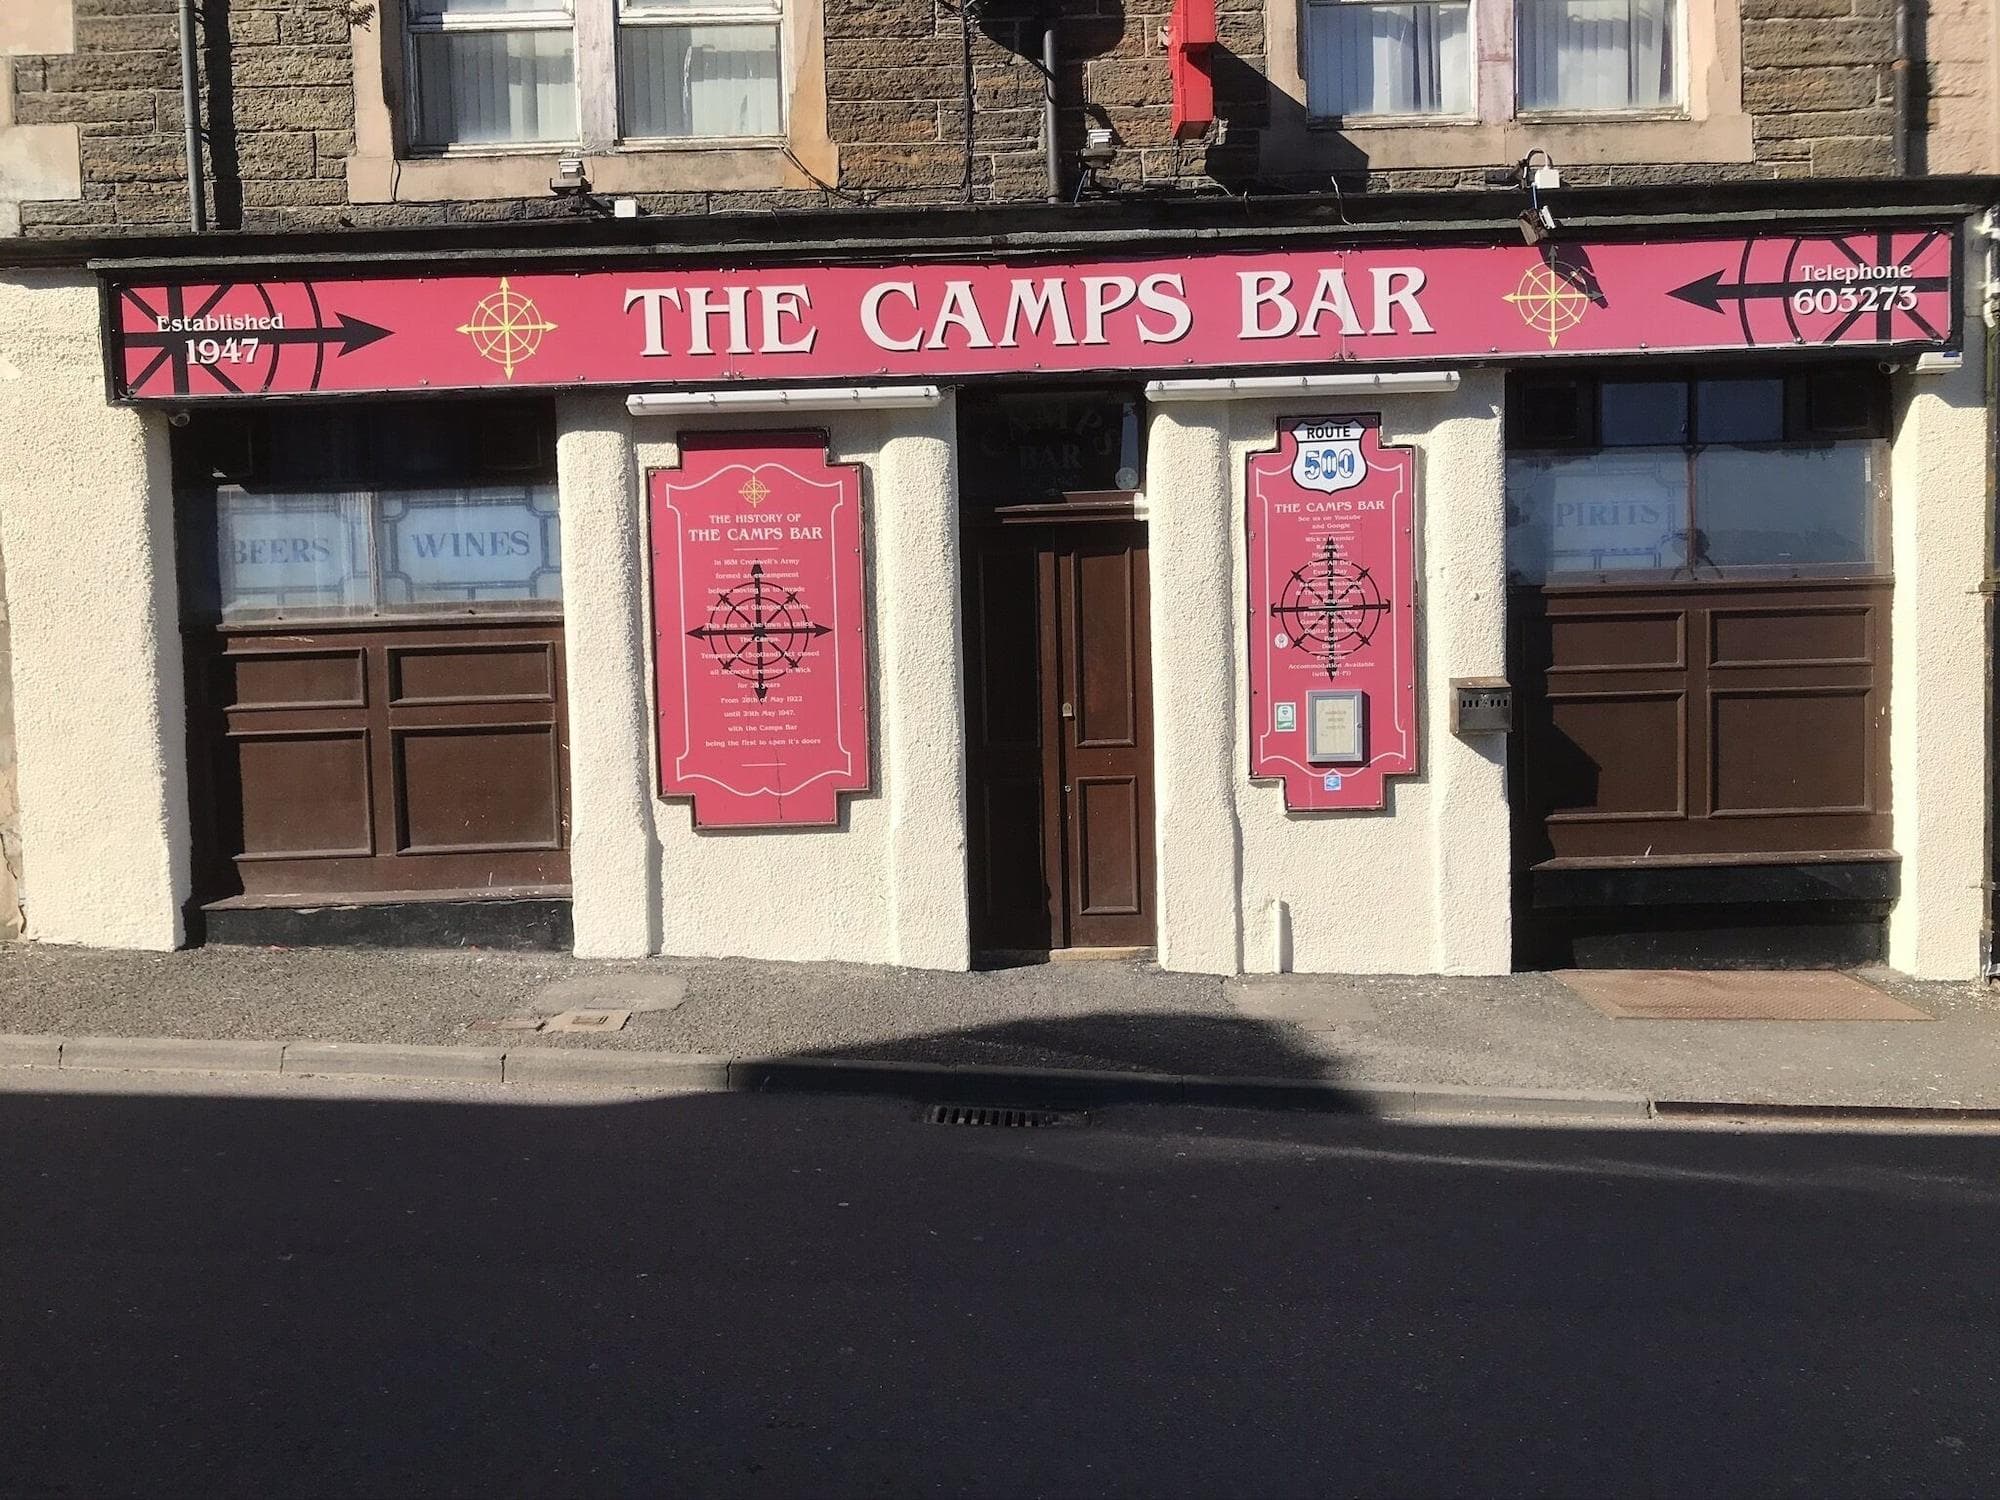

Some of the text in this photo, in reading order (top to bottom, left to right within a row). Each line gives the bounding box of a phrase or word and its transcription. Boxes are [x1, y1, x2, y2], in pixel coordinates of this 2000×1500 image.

[1801, 262, 1912, 285] Telephone
[623, 267, 1436, 357] THE CAMPS BAR
[1793, 286, 1918, 315] 603273
[156, 312, 284, 332] Established
[185, 337, 259, 365] 1947
[1307, 426, 1350, 439] ROUTE
[1305, 449, 1355, 480] 500
[709, 513, 801, 524] THE HISTORY OF
[1274, 501, 1385, 513] THE CAMPS BAR
[1556, 501, 1660, 527] PIRITS
[411, 529, 530, 559] WINES
[688, 527, 823, 542] THE CAMPS BAR
[231, 537, 331, 566] BEERS
[780, 558, 800, 566] Army
